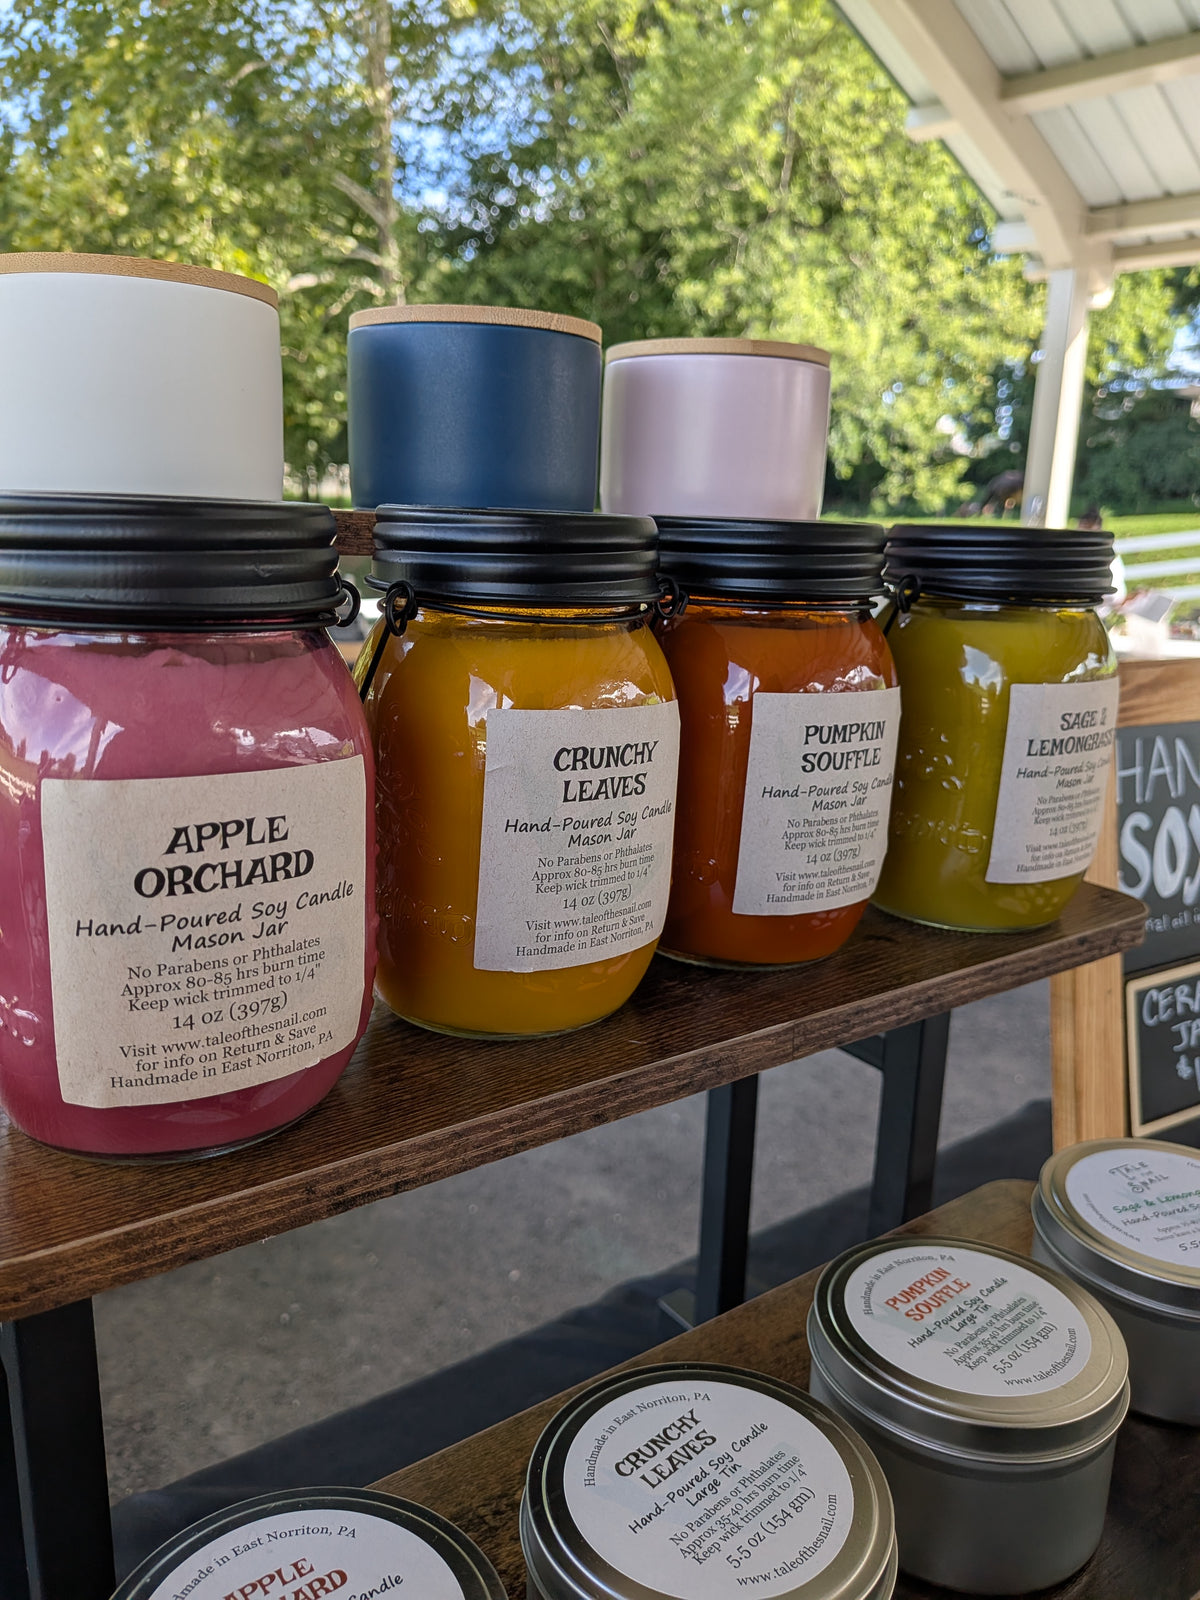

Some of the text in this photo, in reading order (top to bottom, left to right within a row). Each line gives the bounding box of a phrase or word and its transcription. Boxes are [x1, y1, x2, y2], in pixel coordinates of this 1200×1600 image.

[804, 721, 886, 745] PUMPKIN
[1060, 711, 1098, 731] SAGE
[553, 740, 659, 772] CRUNCHY
[801, 748, 881, 773] SOUFFLE
[1016, 765, 1083, 778] Hand-Poured
[562, 772, 647, 802] LEAVES
[762, 781, 849, 798] Hand-Poured
[852, 781, 868, 794] Soy
[812, 796, 867, 811] Mason Jar
[1056, 777, 1081, 789] Mason
[163, 815, 289, 855] APPLE
[505, 800, 672, 833] Hand-Poured Soy Candle
[568, 827, 637, 848] Mason Jar
[134, 849, 314, 898] ORCHARD
[532, 854, 654, 884] Approx 80-85 hrs burn time
[538, 842, 652, 868] No Parabens or Phthalates
[536, 883, 562, 895] Keep
[565, 880, 588, 891] wick
[590, 872, 626, 889] trimmed
[628, 871, 635, 879] to
[563, 884, 632, 910] 14 oz (397g)
[76, 881, 354, 936] Hand-Poured Soy Candle
[526, 900, 652, 932] Visit www.taleofthesnail.com
[535, 913, 645, 943] for info on Return & Save
[172, 921, 288, 952] Mason Jar
[516, 920, 654, 957] Handmade in East Norriton, PA
[121, 950, 325, 1000] Approx 80-85 hrs burn time
[128, 937, 320, 980] No Parabens or Phthalates
[129, 963, 321, 1012] Keep wick trimmed to 1/4"
[120, 1005, 327, 1058] Visit www.taleofthesnail.com
[173, 990, 288, 1031] 14 oz (397g)
[111, 1031, 333, 1088] Handmade in East Norriton, PA
[135, 1024, 317, 1072] for info on Return & Save
[1113, 1202, 1141, 1213] Sage
[884, 1267, 952, 1312] PUMPKIN
[905, 1278, 971, 1322] SOUFFLE
[907, 1277, 1008, 1348] Hand-Poured Soy Candle
[950, 1303, 991, 1332] Large Tin
[992, 1322, 1057, 1374] 5.5 oz (154 gm)
[1004, 1328, 1076, 1386] www.taleofthesnail.com
[584, 1392, 711, 1487] Handmade in East Norriton, PA
[615, 1408, 701, 1476] CRUNCHY
[640, 1429, 717, 1489] LEAVES
[628, 1422, 768, 1534] Hand-Poured Soy Candle
[669, 1450, 786, 1546] No Parabens or Phthalates
[686, 1463, 741, 1506] Large Tin
[680, 1455, 800, 1559] Approx 35-40 hrs burn time
[692, 1464, 807, 1565] Keep wick trimmed to 1/4"
[726, 1486, 816, 1569] 5.5 oz (154 gm)
[213, 1555, 231, 1567] in
[232, 1537, 264, 1557] East
[266, 1525, 333, 1543] Norriton,
[337, 1526, 356, 1538] PA
[736, 1494, 837, 1586] www.taleofthesnail.com
